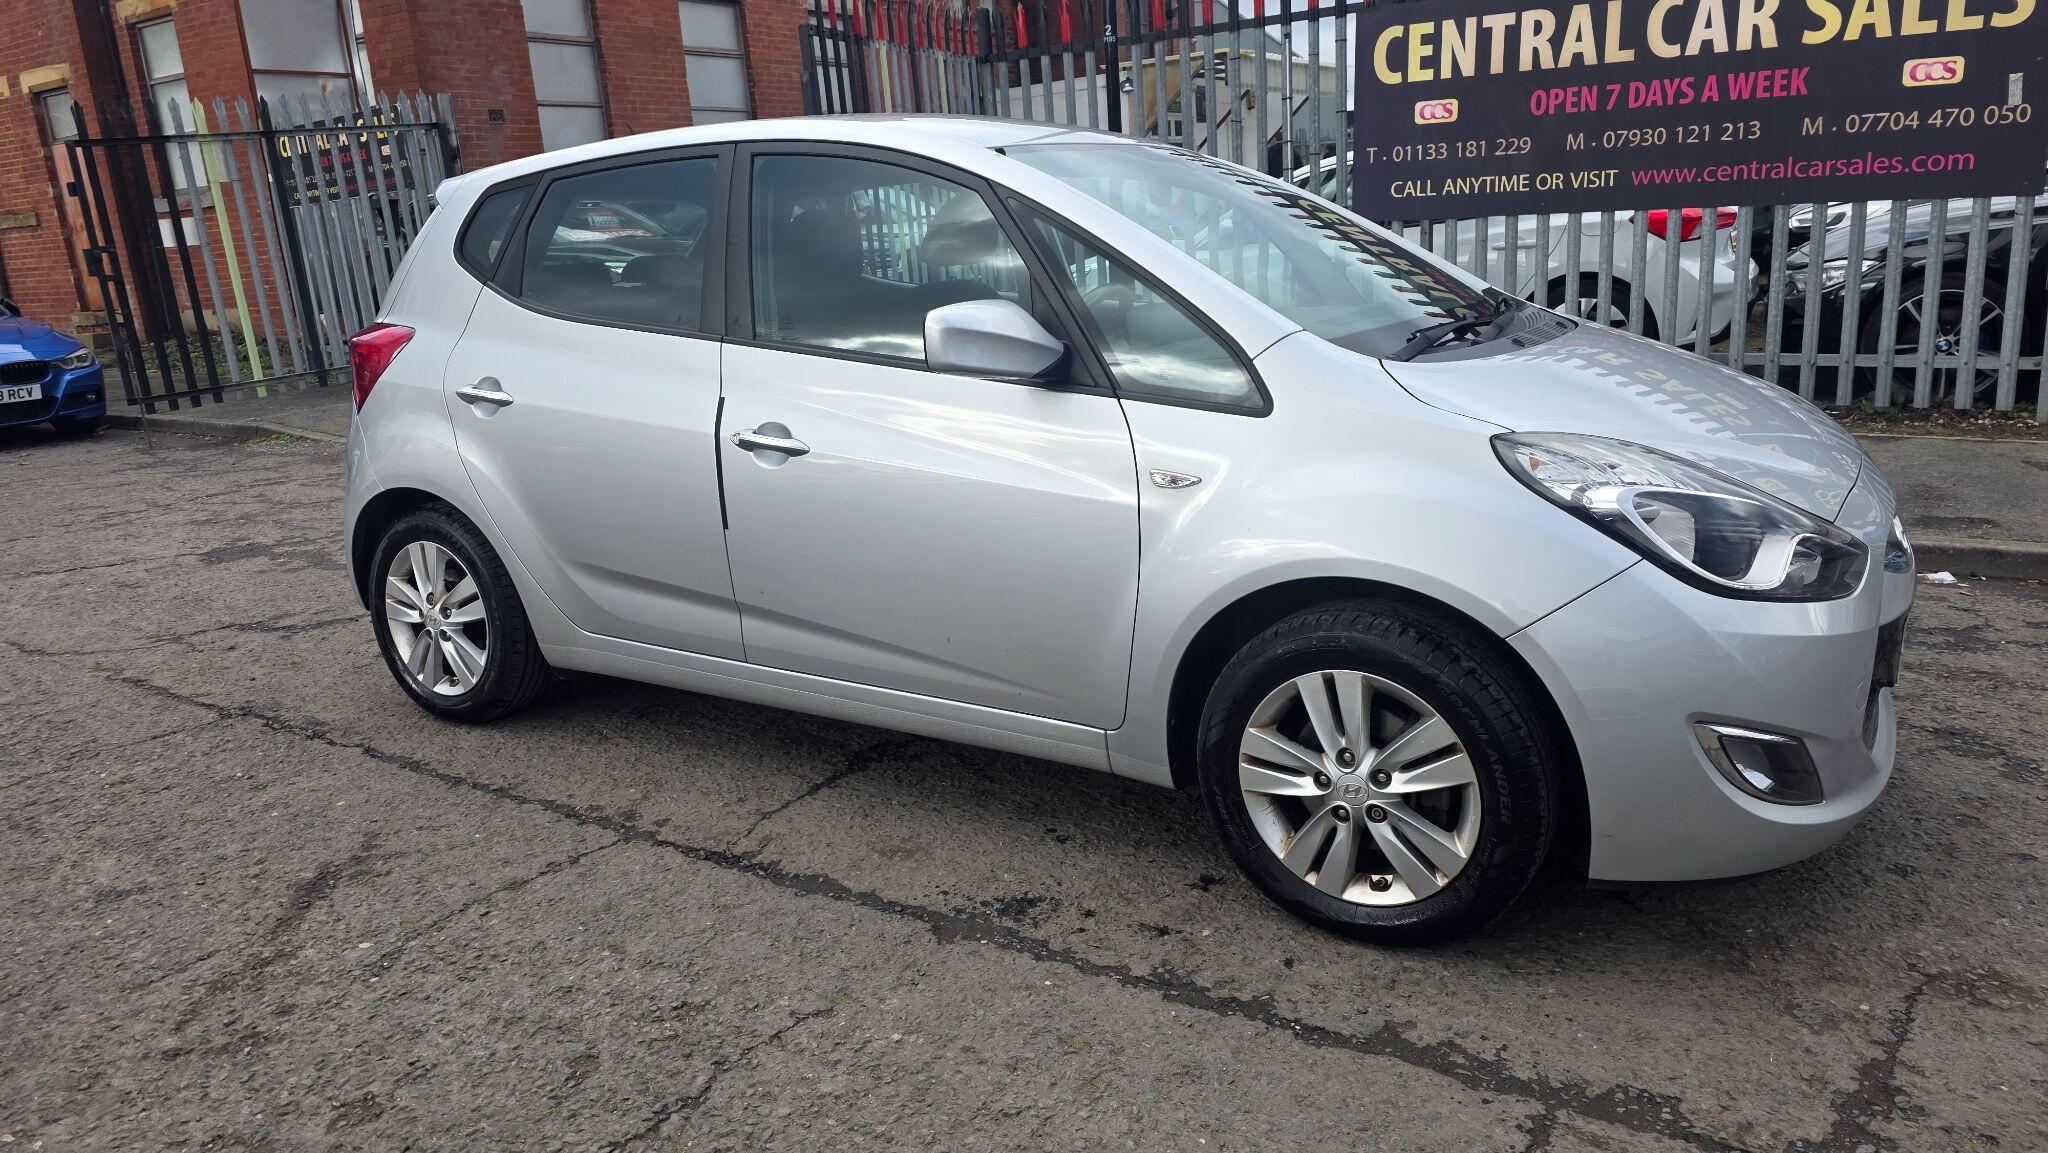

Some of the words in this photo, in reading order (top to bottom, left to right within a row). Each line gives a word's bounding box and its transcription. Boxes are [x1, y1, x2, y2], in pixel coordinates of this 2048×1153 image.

[1105, 24, 1112, 36] 2
[1373, 0, 1635, 85] CENTRAL
[1646, 0, 1780, 58] CAR
[1908, 60, 1958, 82] CCS
[1530, 85, 1598, 116] OPEN
[1606, 84, 1621, 111] 7
[1628, 76, 1695, 109] DAYS
[1700, 75, 1720, 103] A
[1727, 66, 1811, 100] WEEK
[1419, 102, 1453, 121] CCS
[1845, 110, 1920, 133] 07704
[1927, 107, 1975, 129] 470
[1983, 103, 2032, 125] 050
[1602, 127, 1667, 149] 07930
[1675, 124, 1711, 144] 121
[1720, 120, 1761, 141] 213
[1392, 142, 1448, 162] 01133
[1455, 140, 1487, 158] 181
[1494, 136, 1532, 156] 229
[1390, 179, 1437, 198] CALL
[1442, 173, 1530, 195] ANYTIME
[1535, 172, 1564, 191] OR
[1570, 169, 1618, 189] VISIT
[1630, 151, 1976, 186] www.centralcarsales.com
[8, 387, 33, 400] RCV
